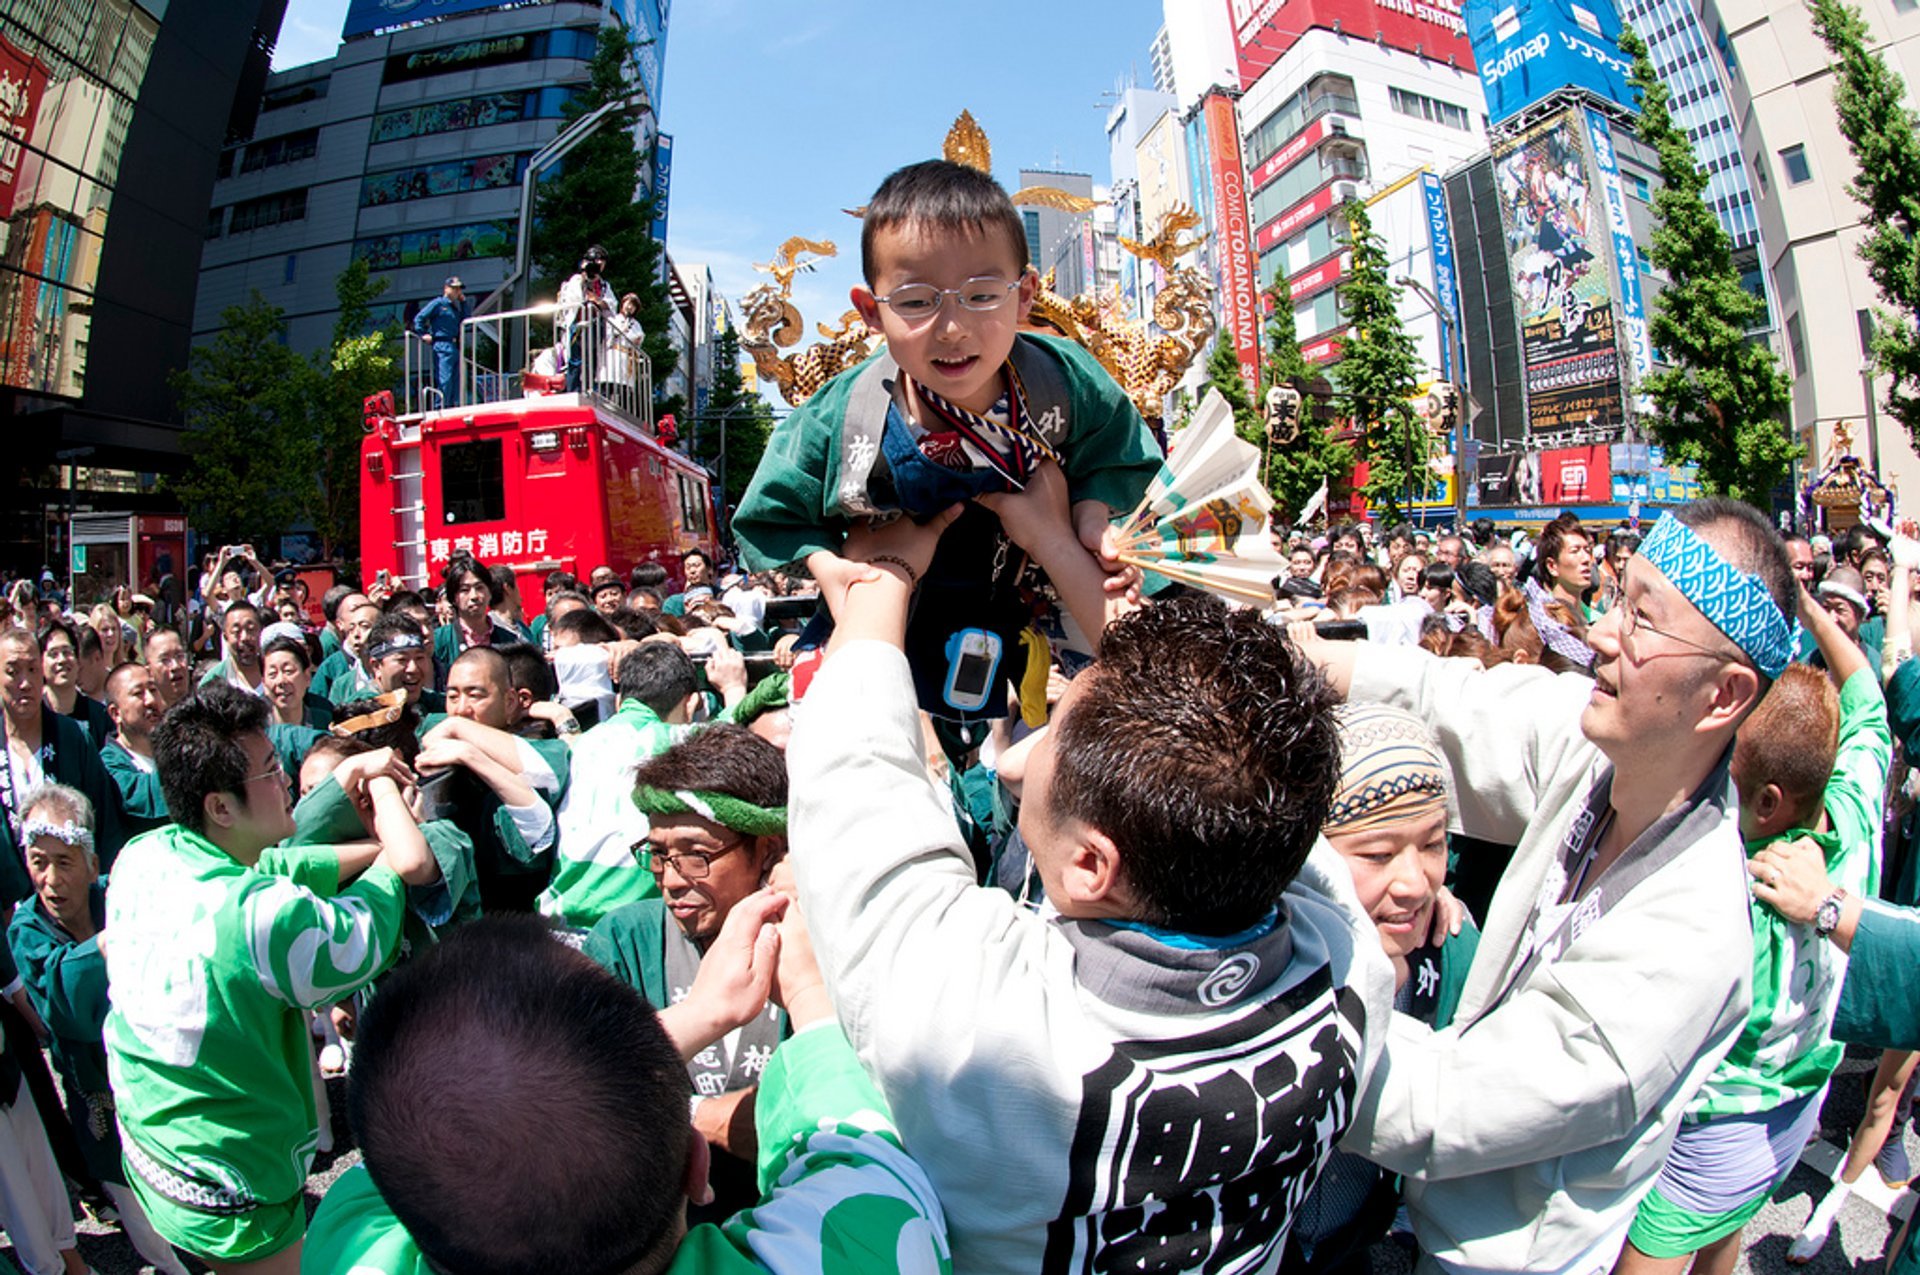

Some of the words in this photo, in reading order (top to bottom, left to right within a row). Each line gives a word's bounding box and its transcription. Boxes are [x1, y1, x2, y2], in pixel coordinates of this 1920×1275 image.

[1482, 32, 1550, 87] Sofmap
[1038, 405, 1066, 434] 外
[1416, 958, 1440, 997] 外
